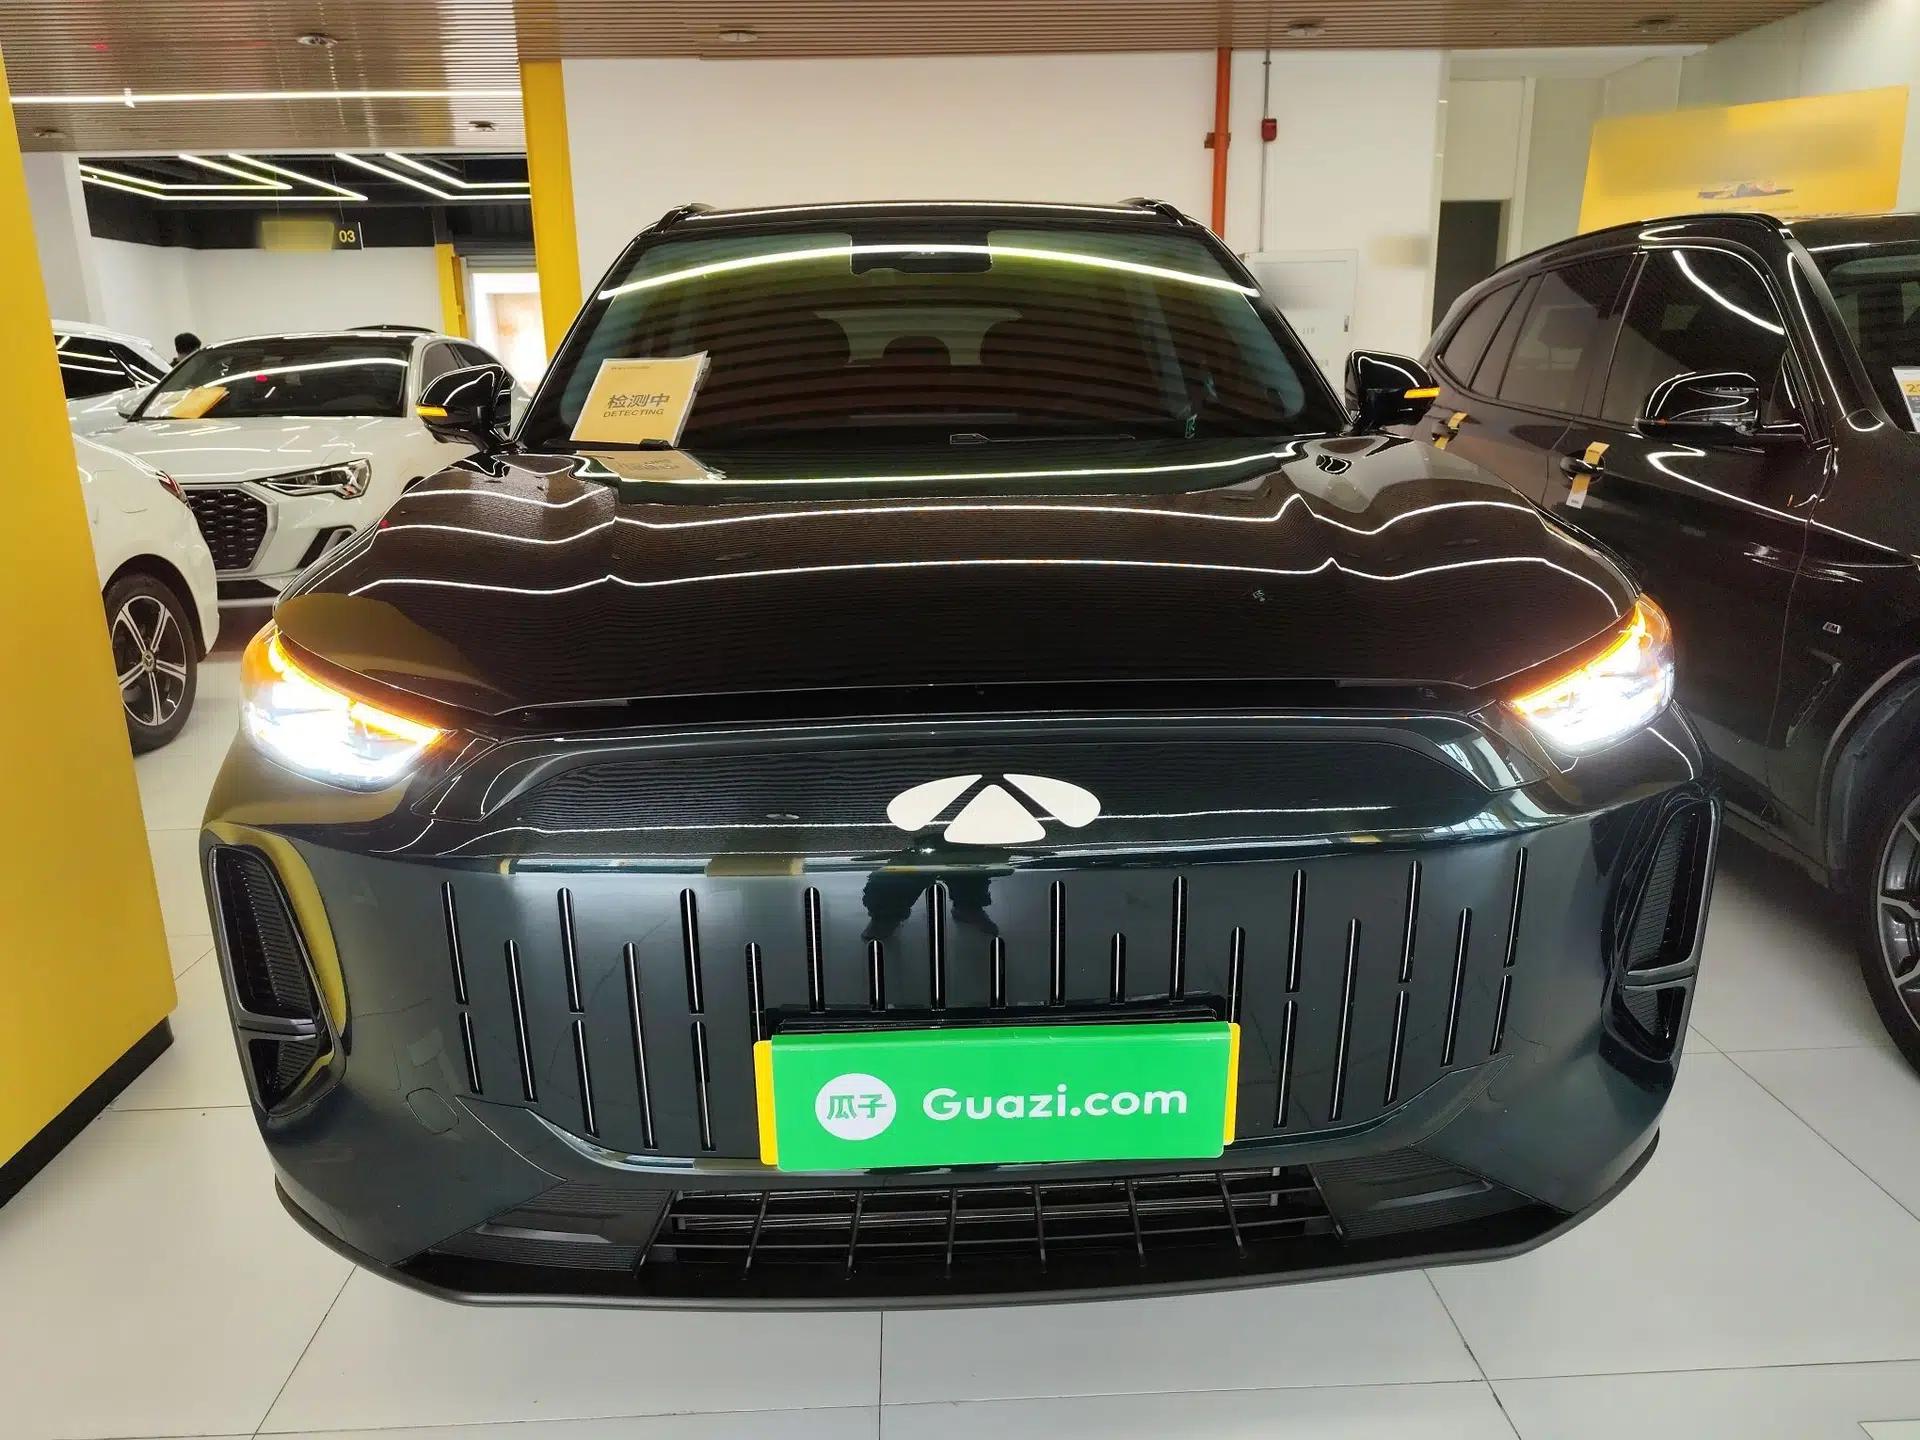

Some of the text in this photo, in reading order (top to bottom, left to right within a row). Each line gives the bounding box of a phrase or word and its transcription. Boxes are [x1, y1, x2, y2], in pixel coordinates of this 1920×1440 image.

[339, 230, 356, 243] 03
[607, 393, 670, 409] 检测中
[603, 408, 665, 418] DETECTING
[826, 1083, 1188, 1121] 瓜子 Guazi.com
